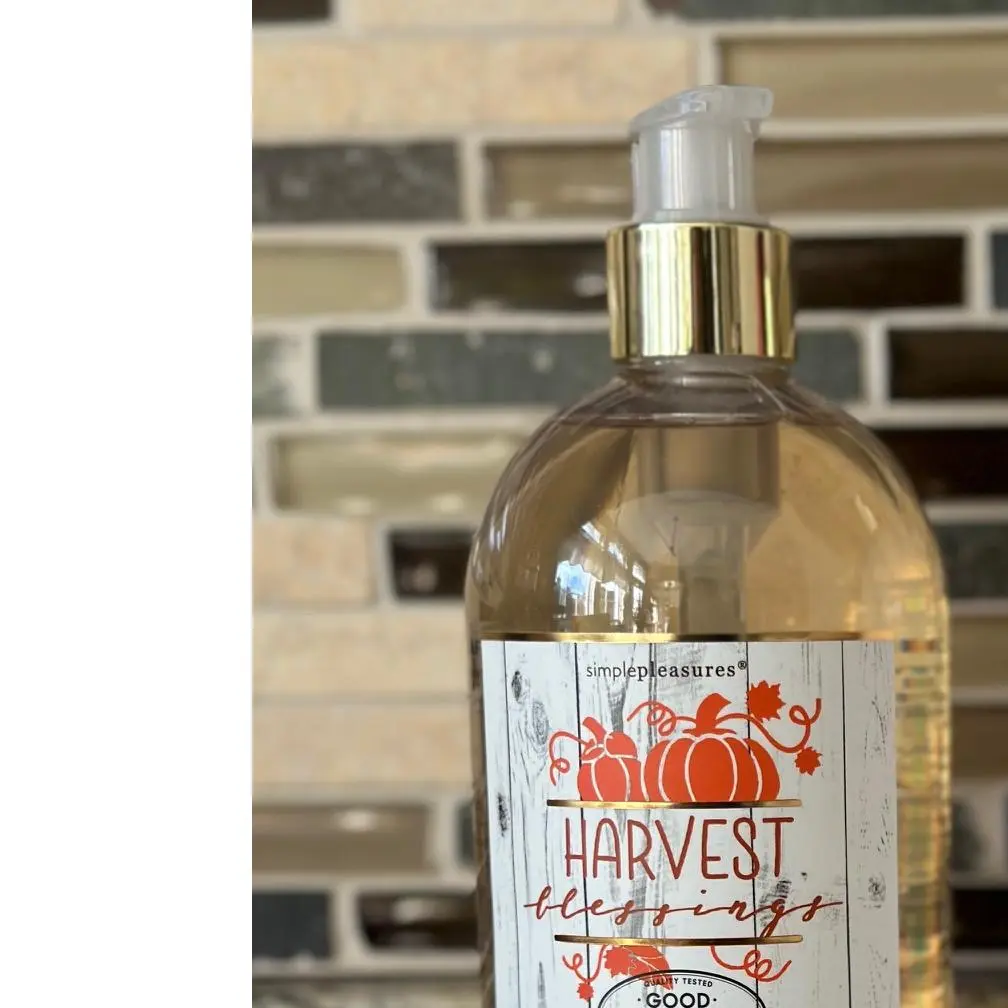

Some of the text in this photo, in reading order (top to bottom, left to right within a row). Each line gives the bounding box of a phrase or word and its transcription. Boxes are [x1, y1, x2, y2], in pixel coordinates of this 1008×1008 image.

[565, 816, 794, 881] HARVEST
[524, 885, 843, 938] blessings
[643, 977, 713, 988] QUALITY TESTED
[646, 992, 710, 1008] GOOD
